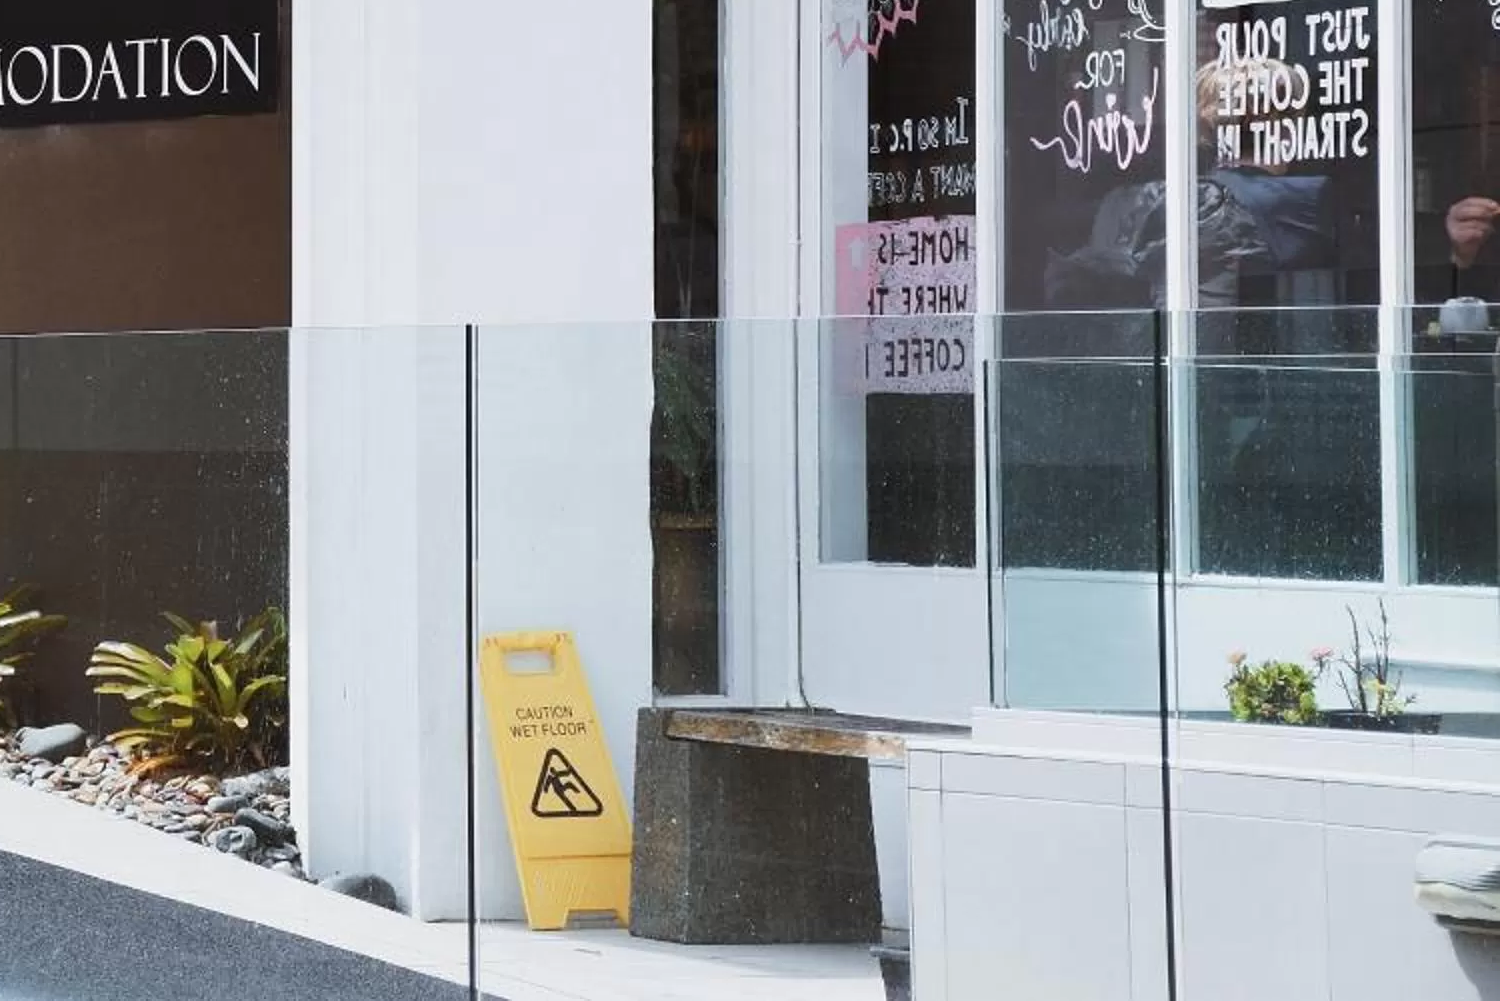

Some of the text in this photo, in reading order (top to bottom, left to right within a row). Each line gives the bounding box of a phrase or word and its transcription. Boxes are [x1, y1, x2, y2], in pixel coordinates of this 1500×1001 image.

[515, 704, 573, 720] CAUTION
[508, 722, 587, 738] WET FLOOR
